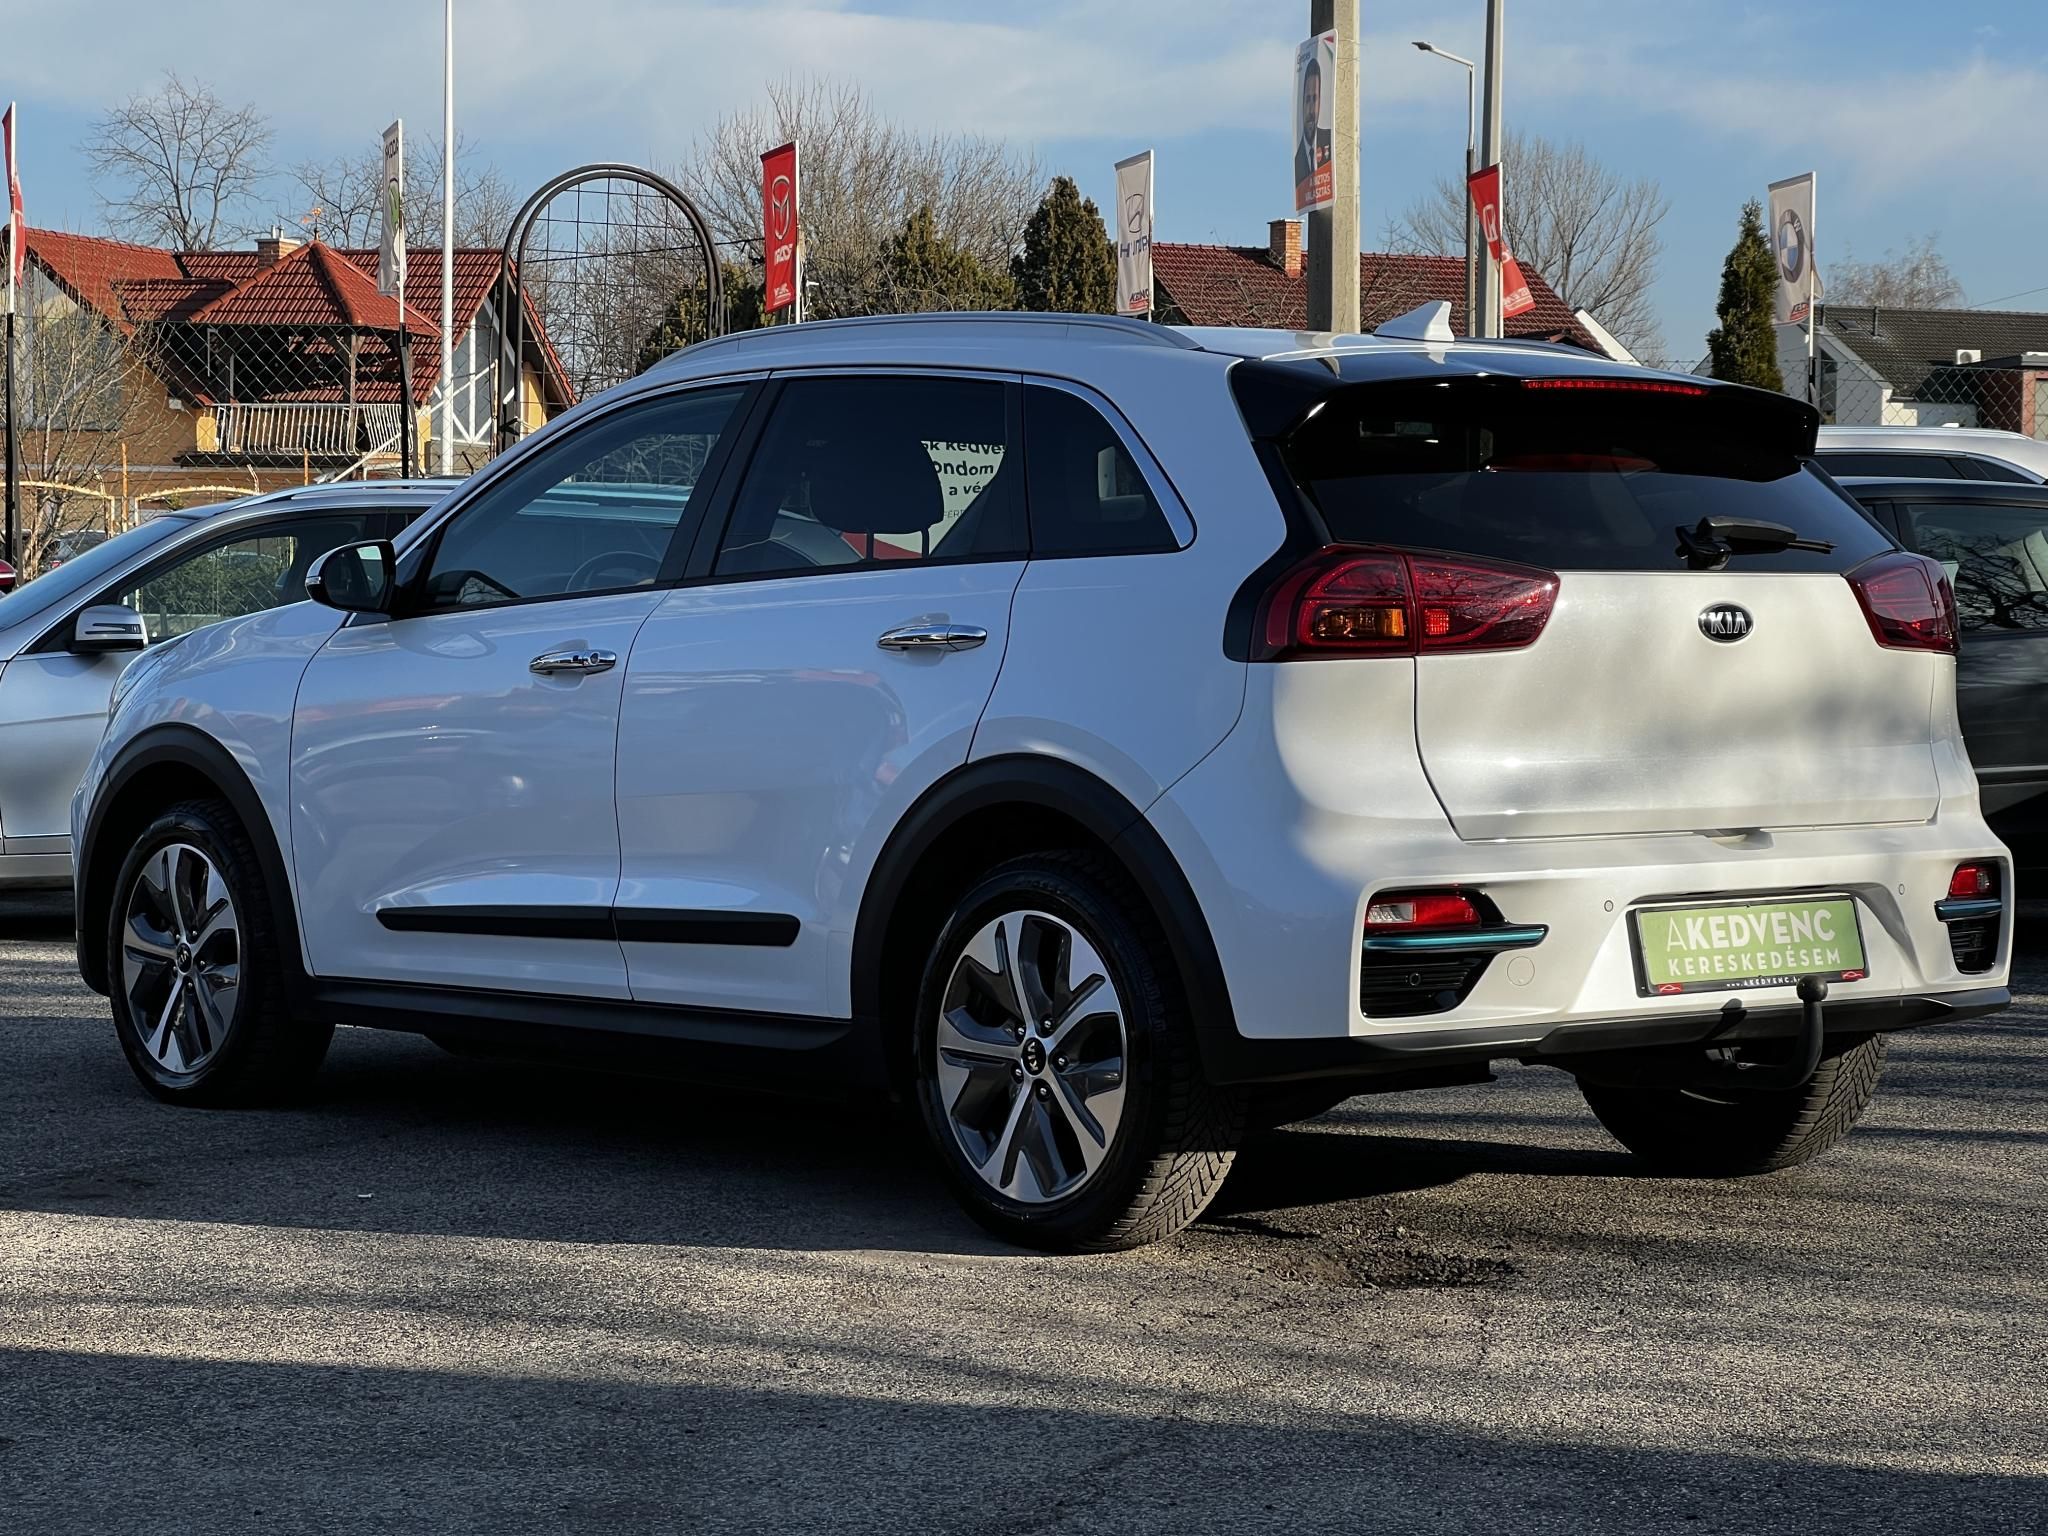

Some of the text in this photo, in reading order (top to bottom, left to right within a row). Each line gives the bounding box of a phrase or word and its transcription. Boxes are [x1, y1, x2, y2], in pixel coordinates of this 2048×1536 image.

[949, 486, 958, 496] a
[1708, 611, 1747, 634] KIA
[1666, 908, 1836, 953] AKEDVENC
[1668, 945, 1841, 977] KERESKEDÉSEM
